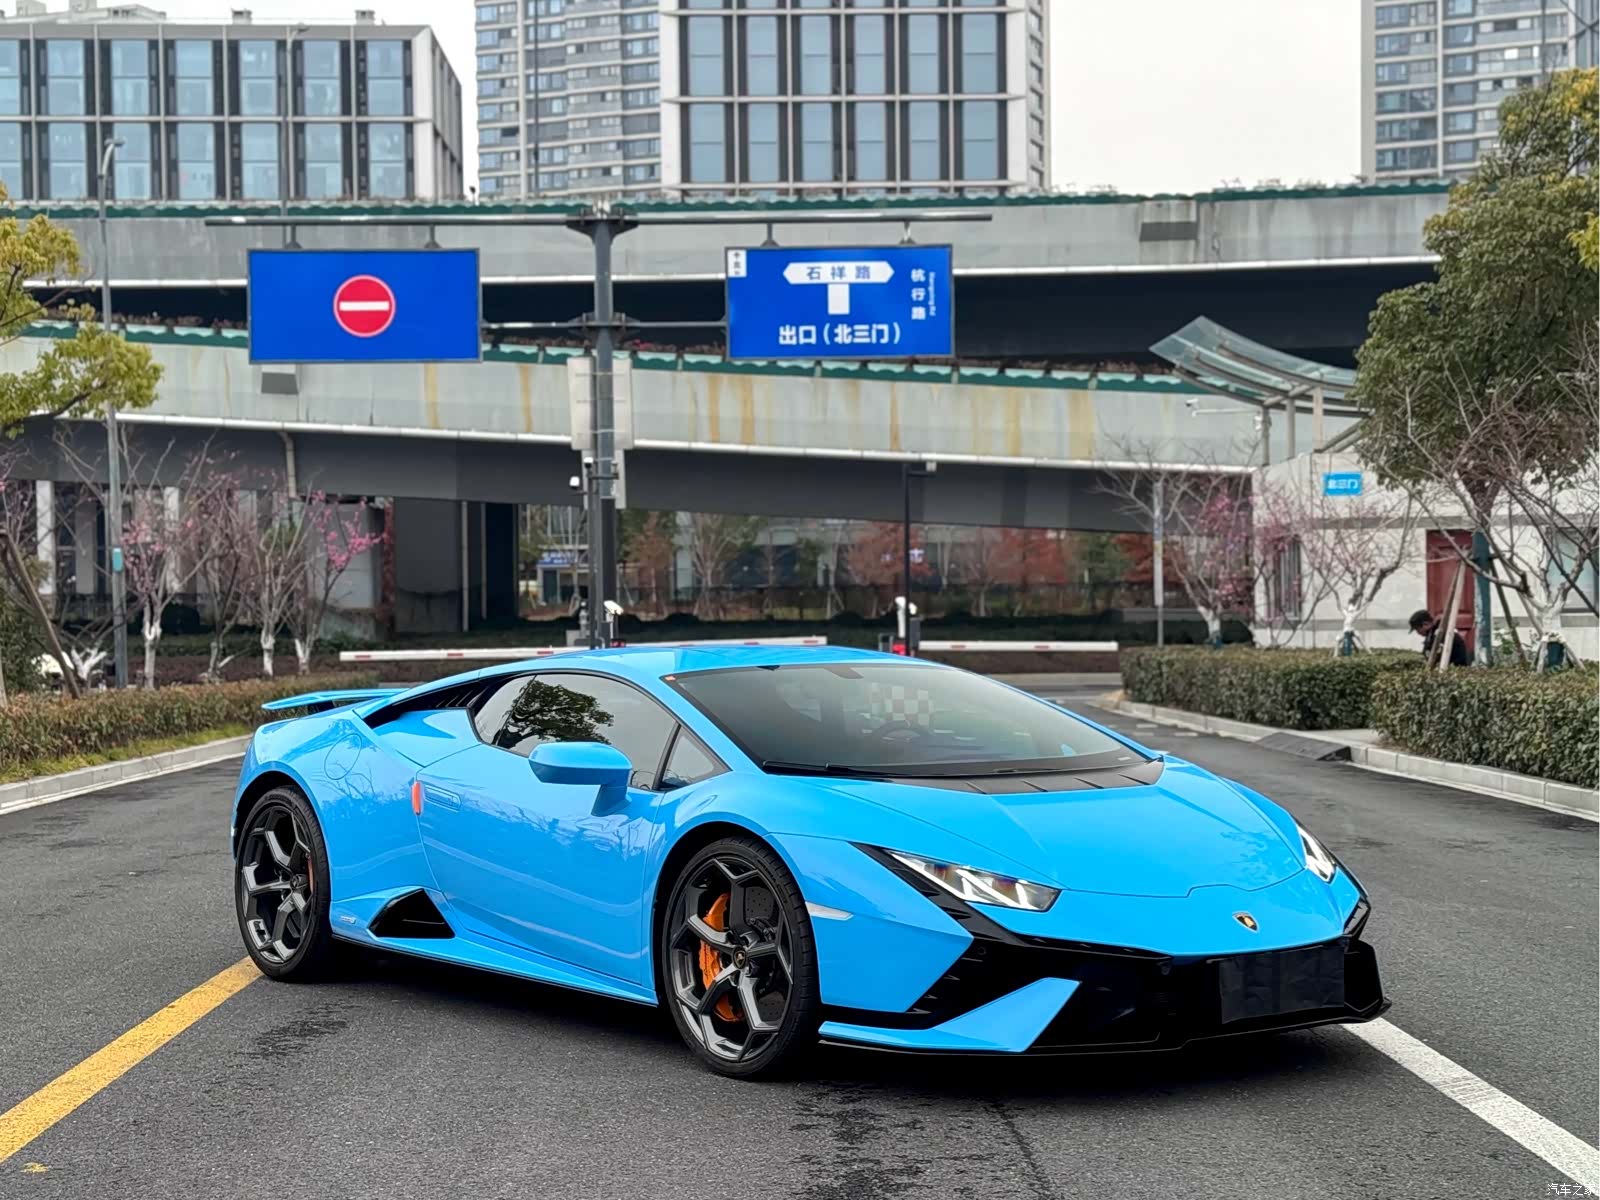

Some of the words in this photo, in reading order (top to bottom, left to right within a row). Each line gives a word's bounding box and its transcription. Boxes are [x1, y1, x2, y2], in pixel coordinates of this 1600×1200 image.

[806, 265, 871, 281] 石祥路
[778, 321, 901, 346] 出口（北三门）
